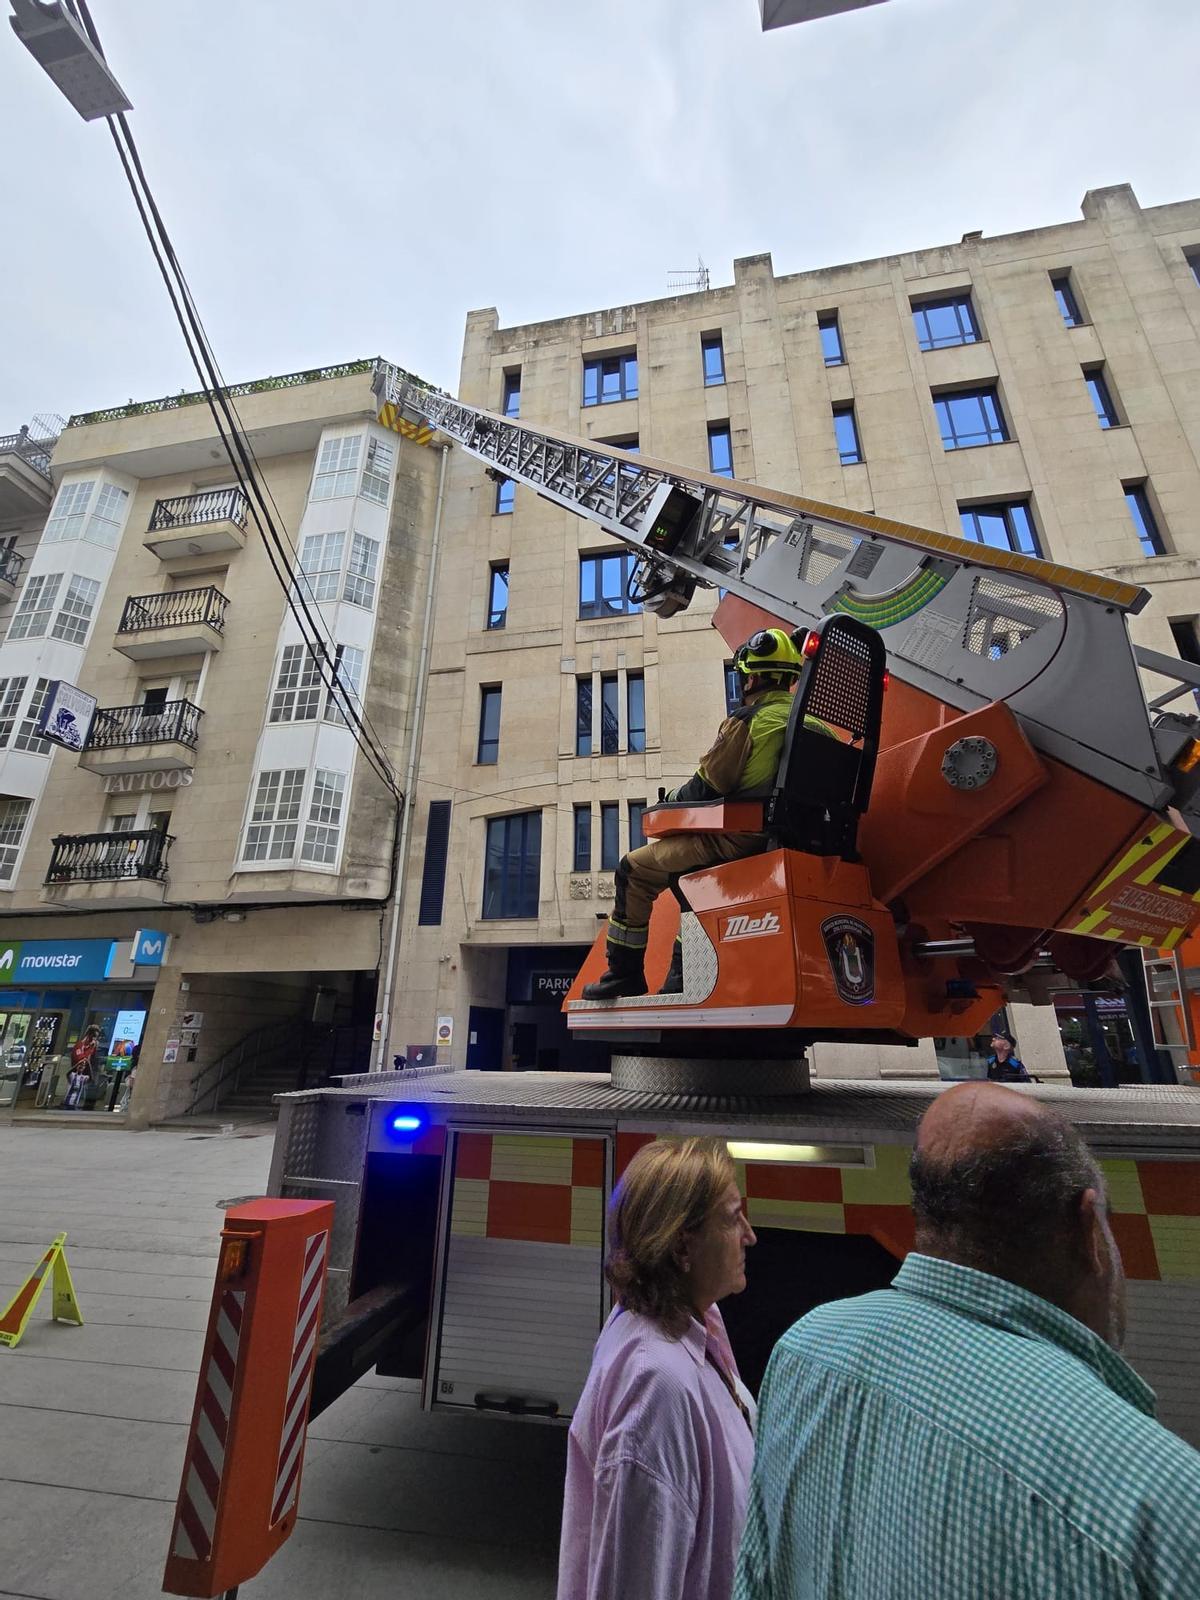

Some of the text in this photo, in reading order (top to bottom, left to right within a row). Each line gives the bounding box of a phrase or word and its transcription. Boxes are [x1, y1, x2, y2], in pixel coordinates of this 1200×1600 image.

[104, 768, 194, 793] TATTOOS
[724, 912, 780, 938] Metz
[21, 954, 82, 968] movistar
